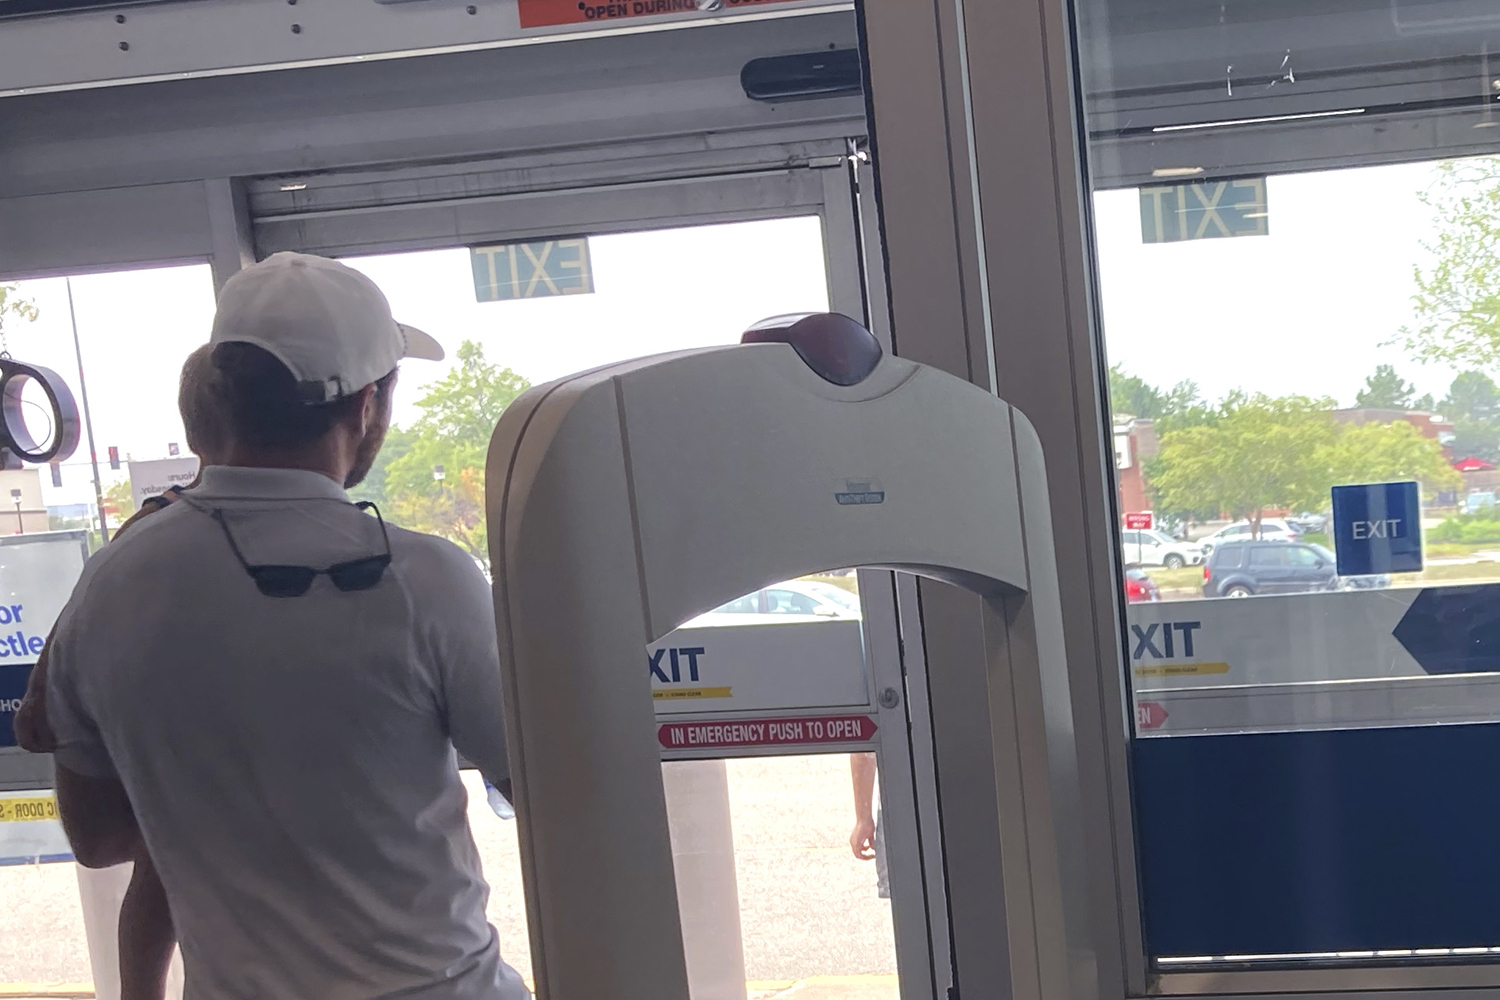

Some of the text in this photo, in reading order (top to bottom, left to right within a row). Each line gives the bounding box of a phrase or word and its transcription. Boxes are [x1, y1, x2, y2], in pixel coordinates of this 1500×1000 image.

[585, 3, 628, 19] OPEN
[1352, 519, 1402, 540] EXIT
[1131, 621, 1201, 660] XIT
[648, 646, 706, 683] XIT
[670, 719, 862, 745] IN EMERGENCY PUSH TO OPEN
